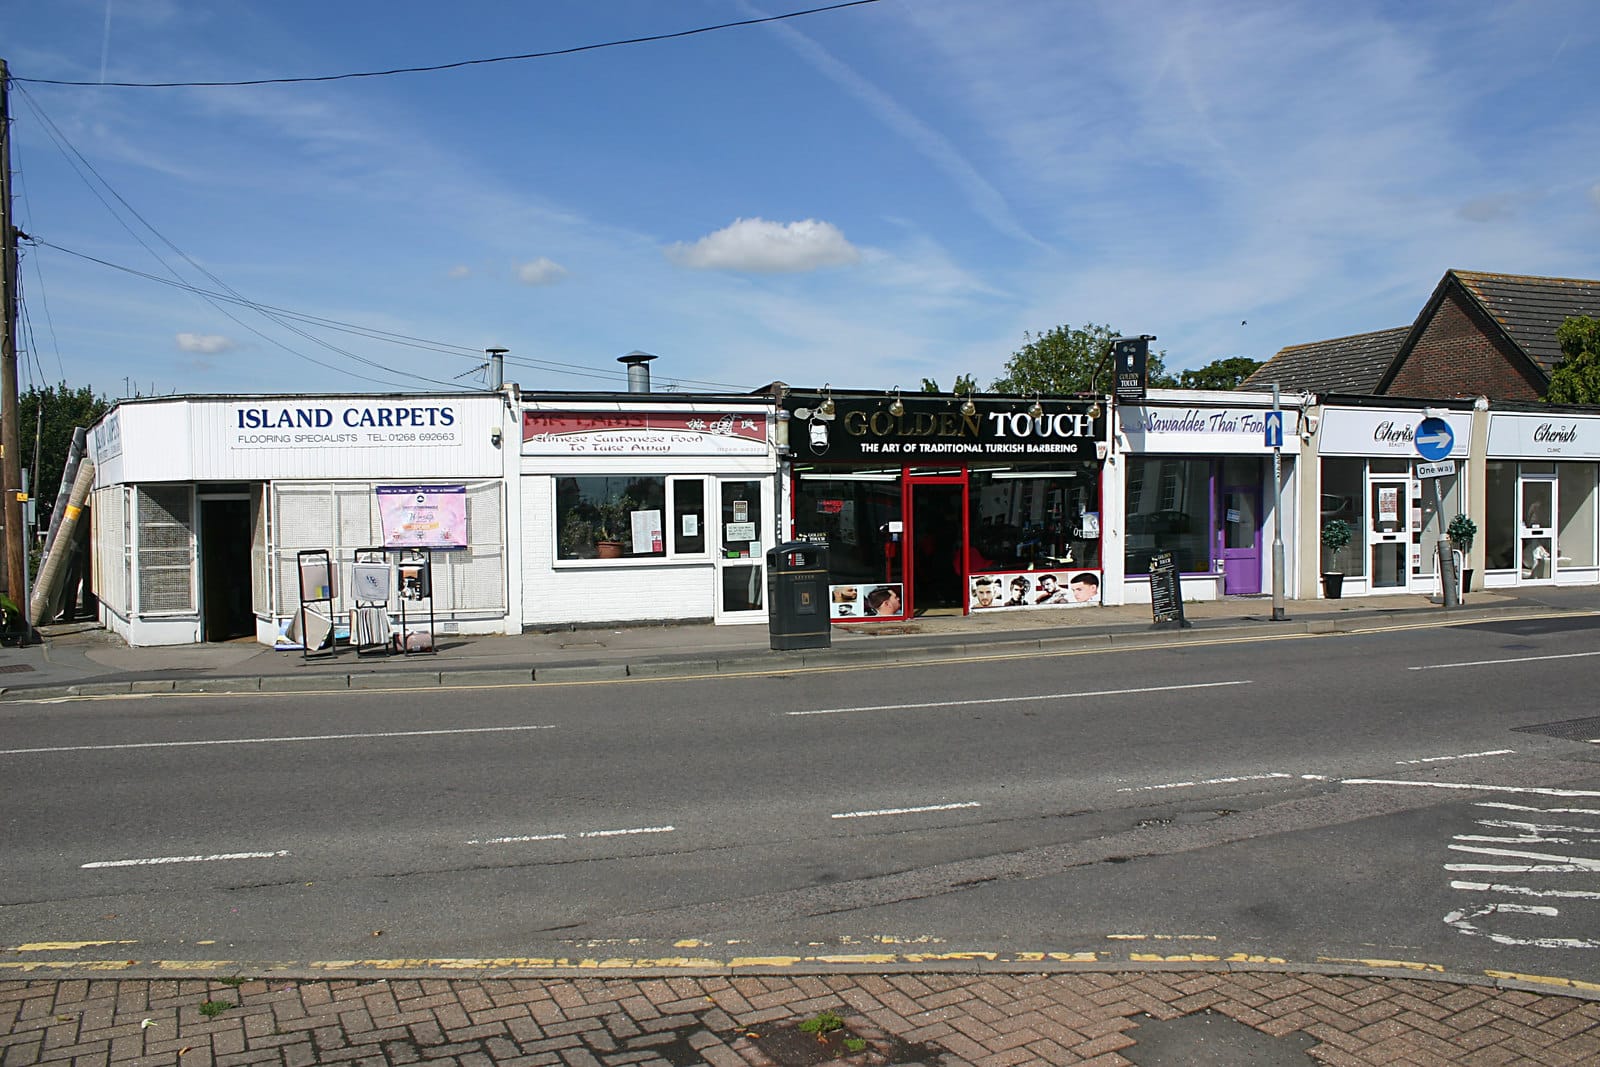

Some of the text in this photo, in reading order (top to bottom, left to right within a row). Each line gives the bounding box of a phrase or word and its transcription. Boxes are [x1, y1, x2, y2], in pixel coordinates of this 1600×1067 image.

[237, 407, 455, 429] ISLAND CARPETS
[844, 410, 1096, 438] GOLDEN TOUCH
[1147, 410, 1265, 433] Sawaddee Thai Foo
[238, 434, 292, 444] FLOORING
[294, 433, 358, 443] SPECIALISTS
[418, 432, 455, 441] 692663
[534, 432, 703, 443] Chinese Cantonese Food
[1374, 420, 1414, 442] Cheris
[1533, 423, 1577, 442] Cherish
[568, 443, 671, 454] To Take Away
[861, 443, 1078, 453] THE ART OF TRADITIONAL TURKISH BARBERING
[1419, 465, 1453, 475] One way
